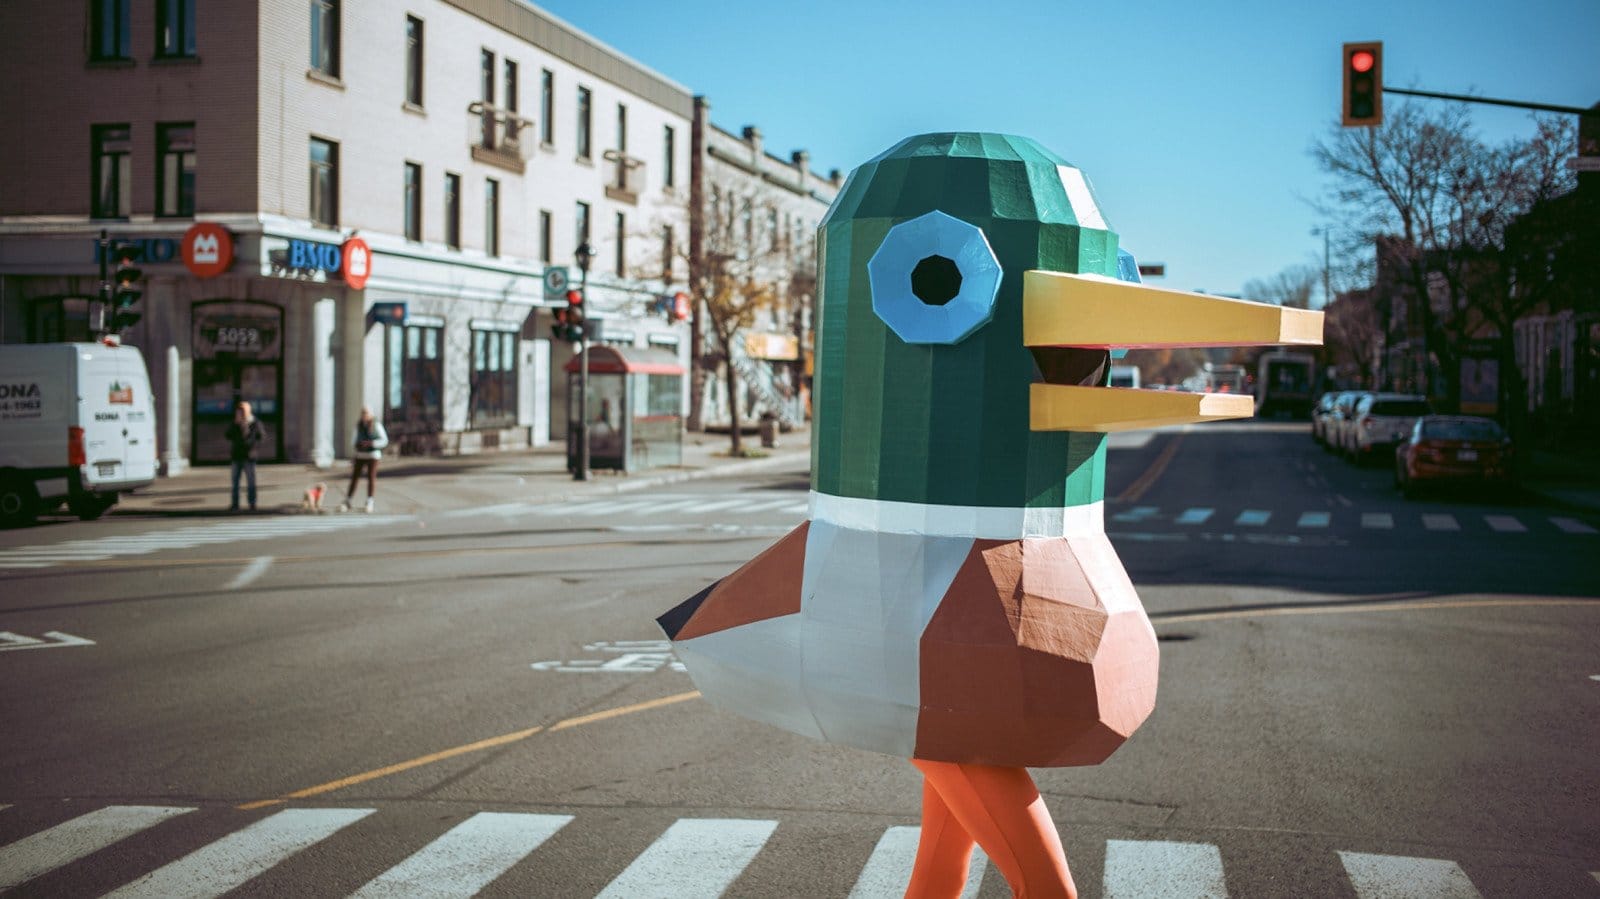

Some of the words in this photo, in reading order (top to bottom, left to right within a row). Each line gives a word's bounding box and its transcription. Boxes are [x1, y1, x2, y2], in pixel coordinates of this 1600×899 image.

[290, 239, 341, 272] BMO
[218, 327, 258, 345] 5059
[95, 411, 119, 421] BONA
